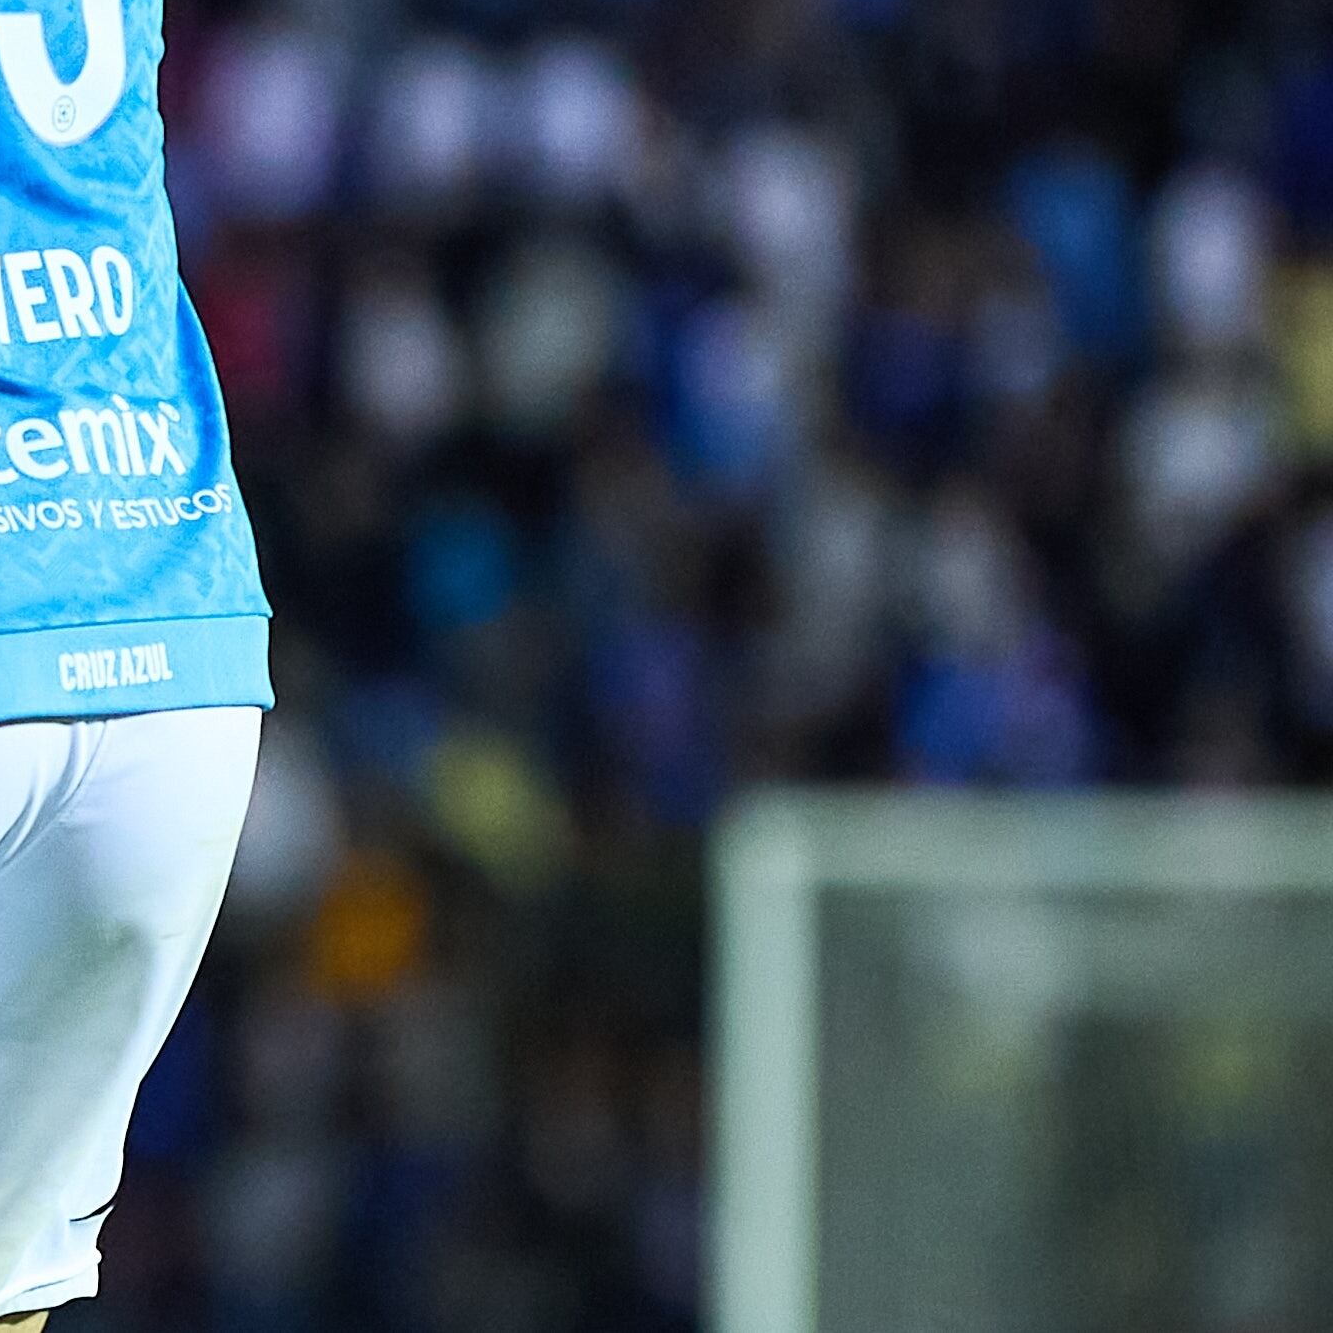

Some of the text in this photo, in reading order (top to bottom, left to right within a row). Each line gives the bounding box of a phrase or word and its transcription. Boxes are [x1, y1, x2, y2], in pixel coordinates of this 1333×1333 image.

[85, 498, 104, 530] Y
[107, 482, 234, 531] ESTUCOS
[58, 641, 174, 692] CRUZ AZUL
